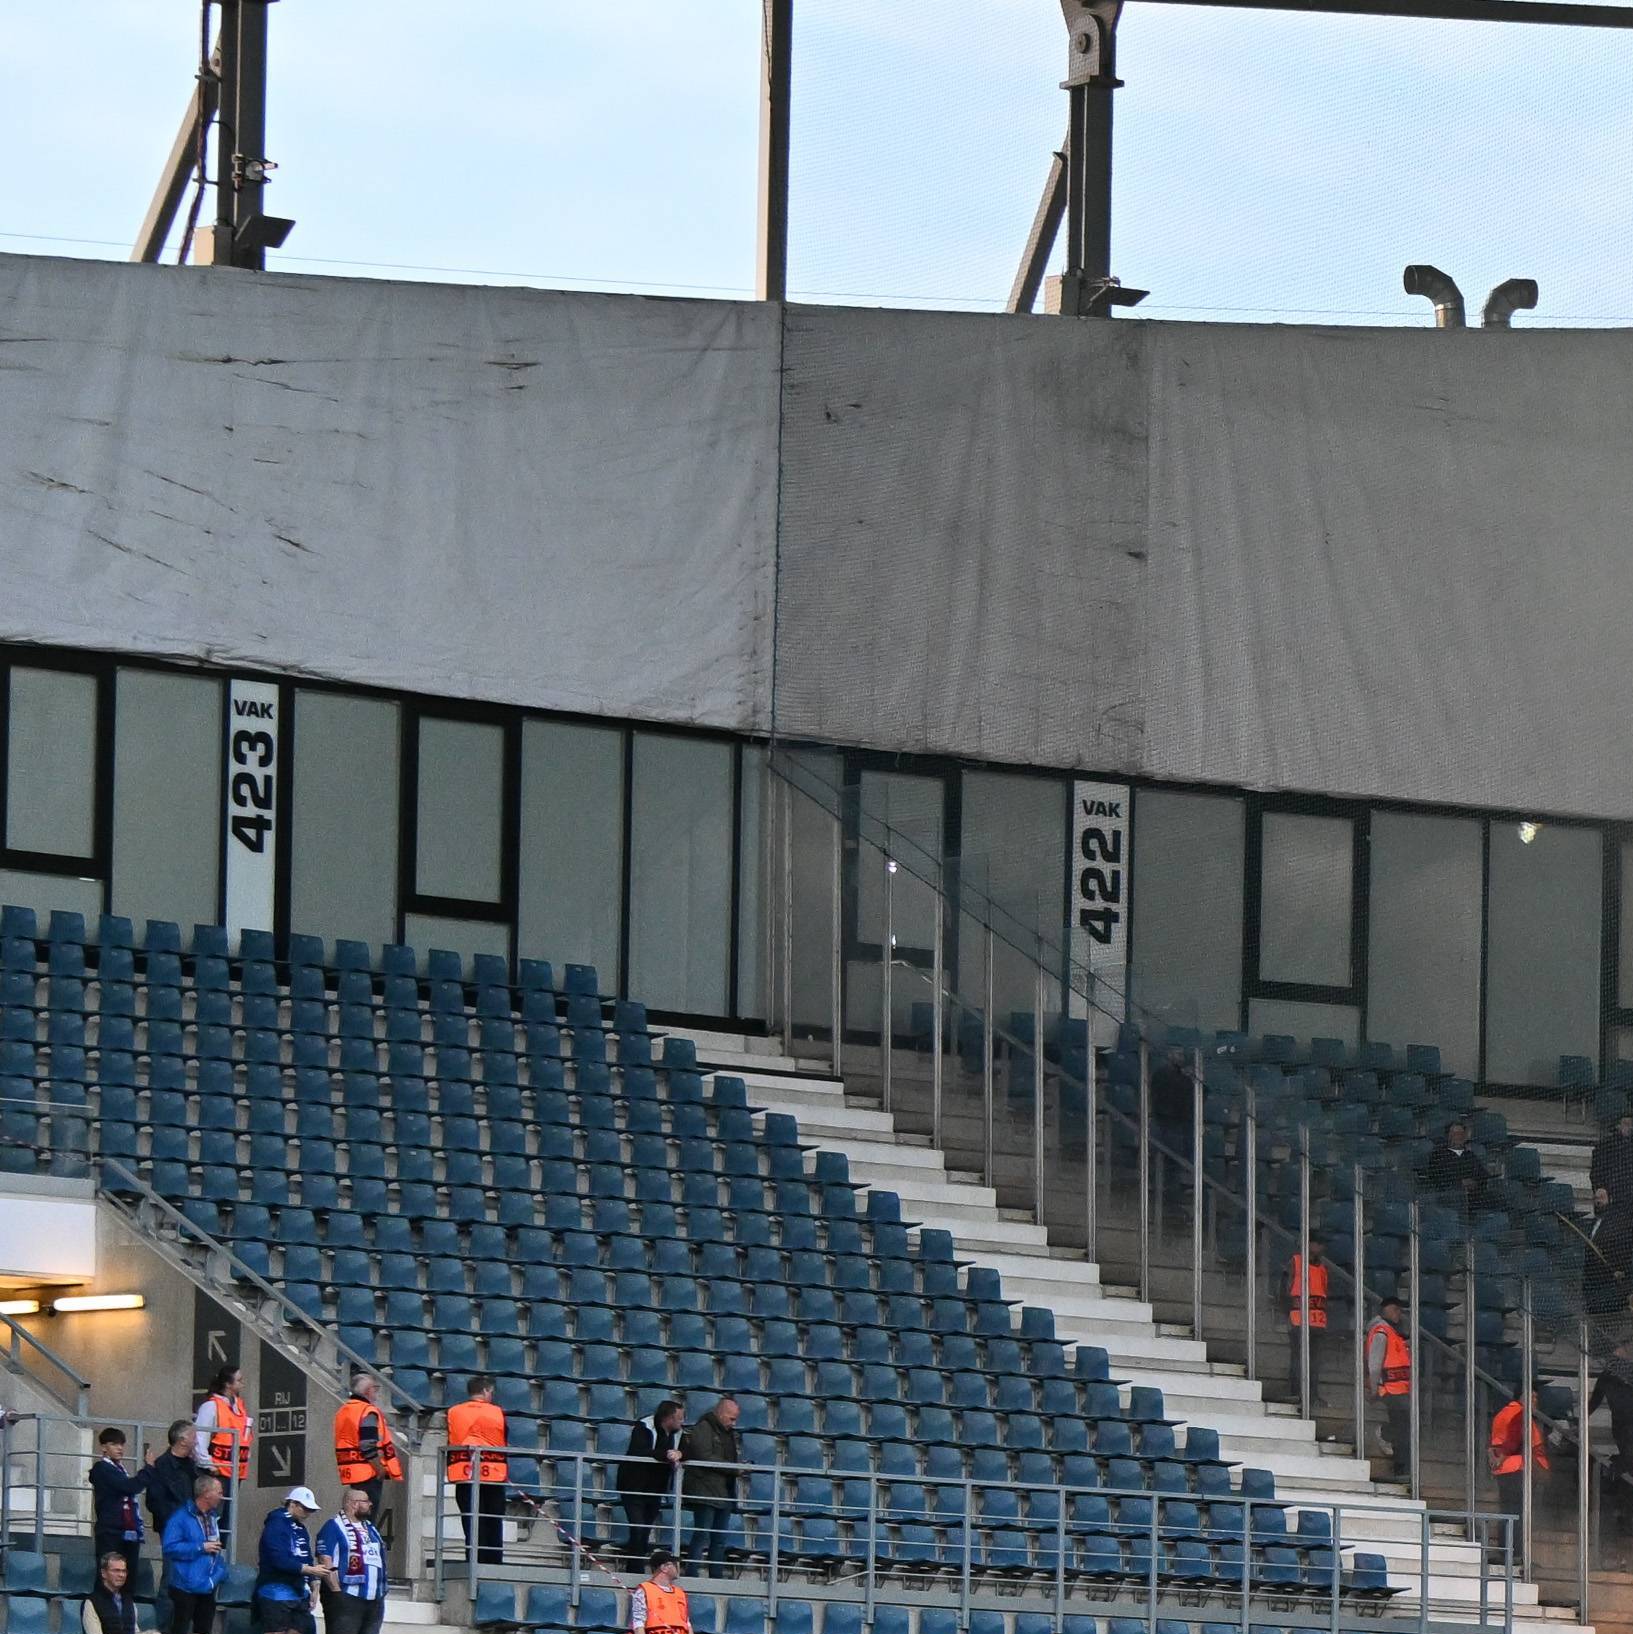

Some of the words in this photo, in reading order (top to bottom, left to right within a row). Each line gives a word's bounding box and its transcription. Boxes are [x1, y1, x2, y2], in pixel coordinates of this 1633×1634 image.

[234, 700, 274, 720] VAK
[232, 728, 274, 854] 423
[1081, 799, 1122, 819] VAK
[1080, 828, 1121, 945] 422
[450, 1450, 506, 1462] STEARD
